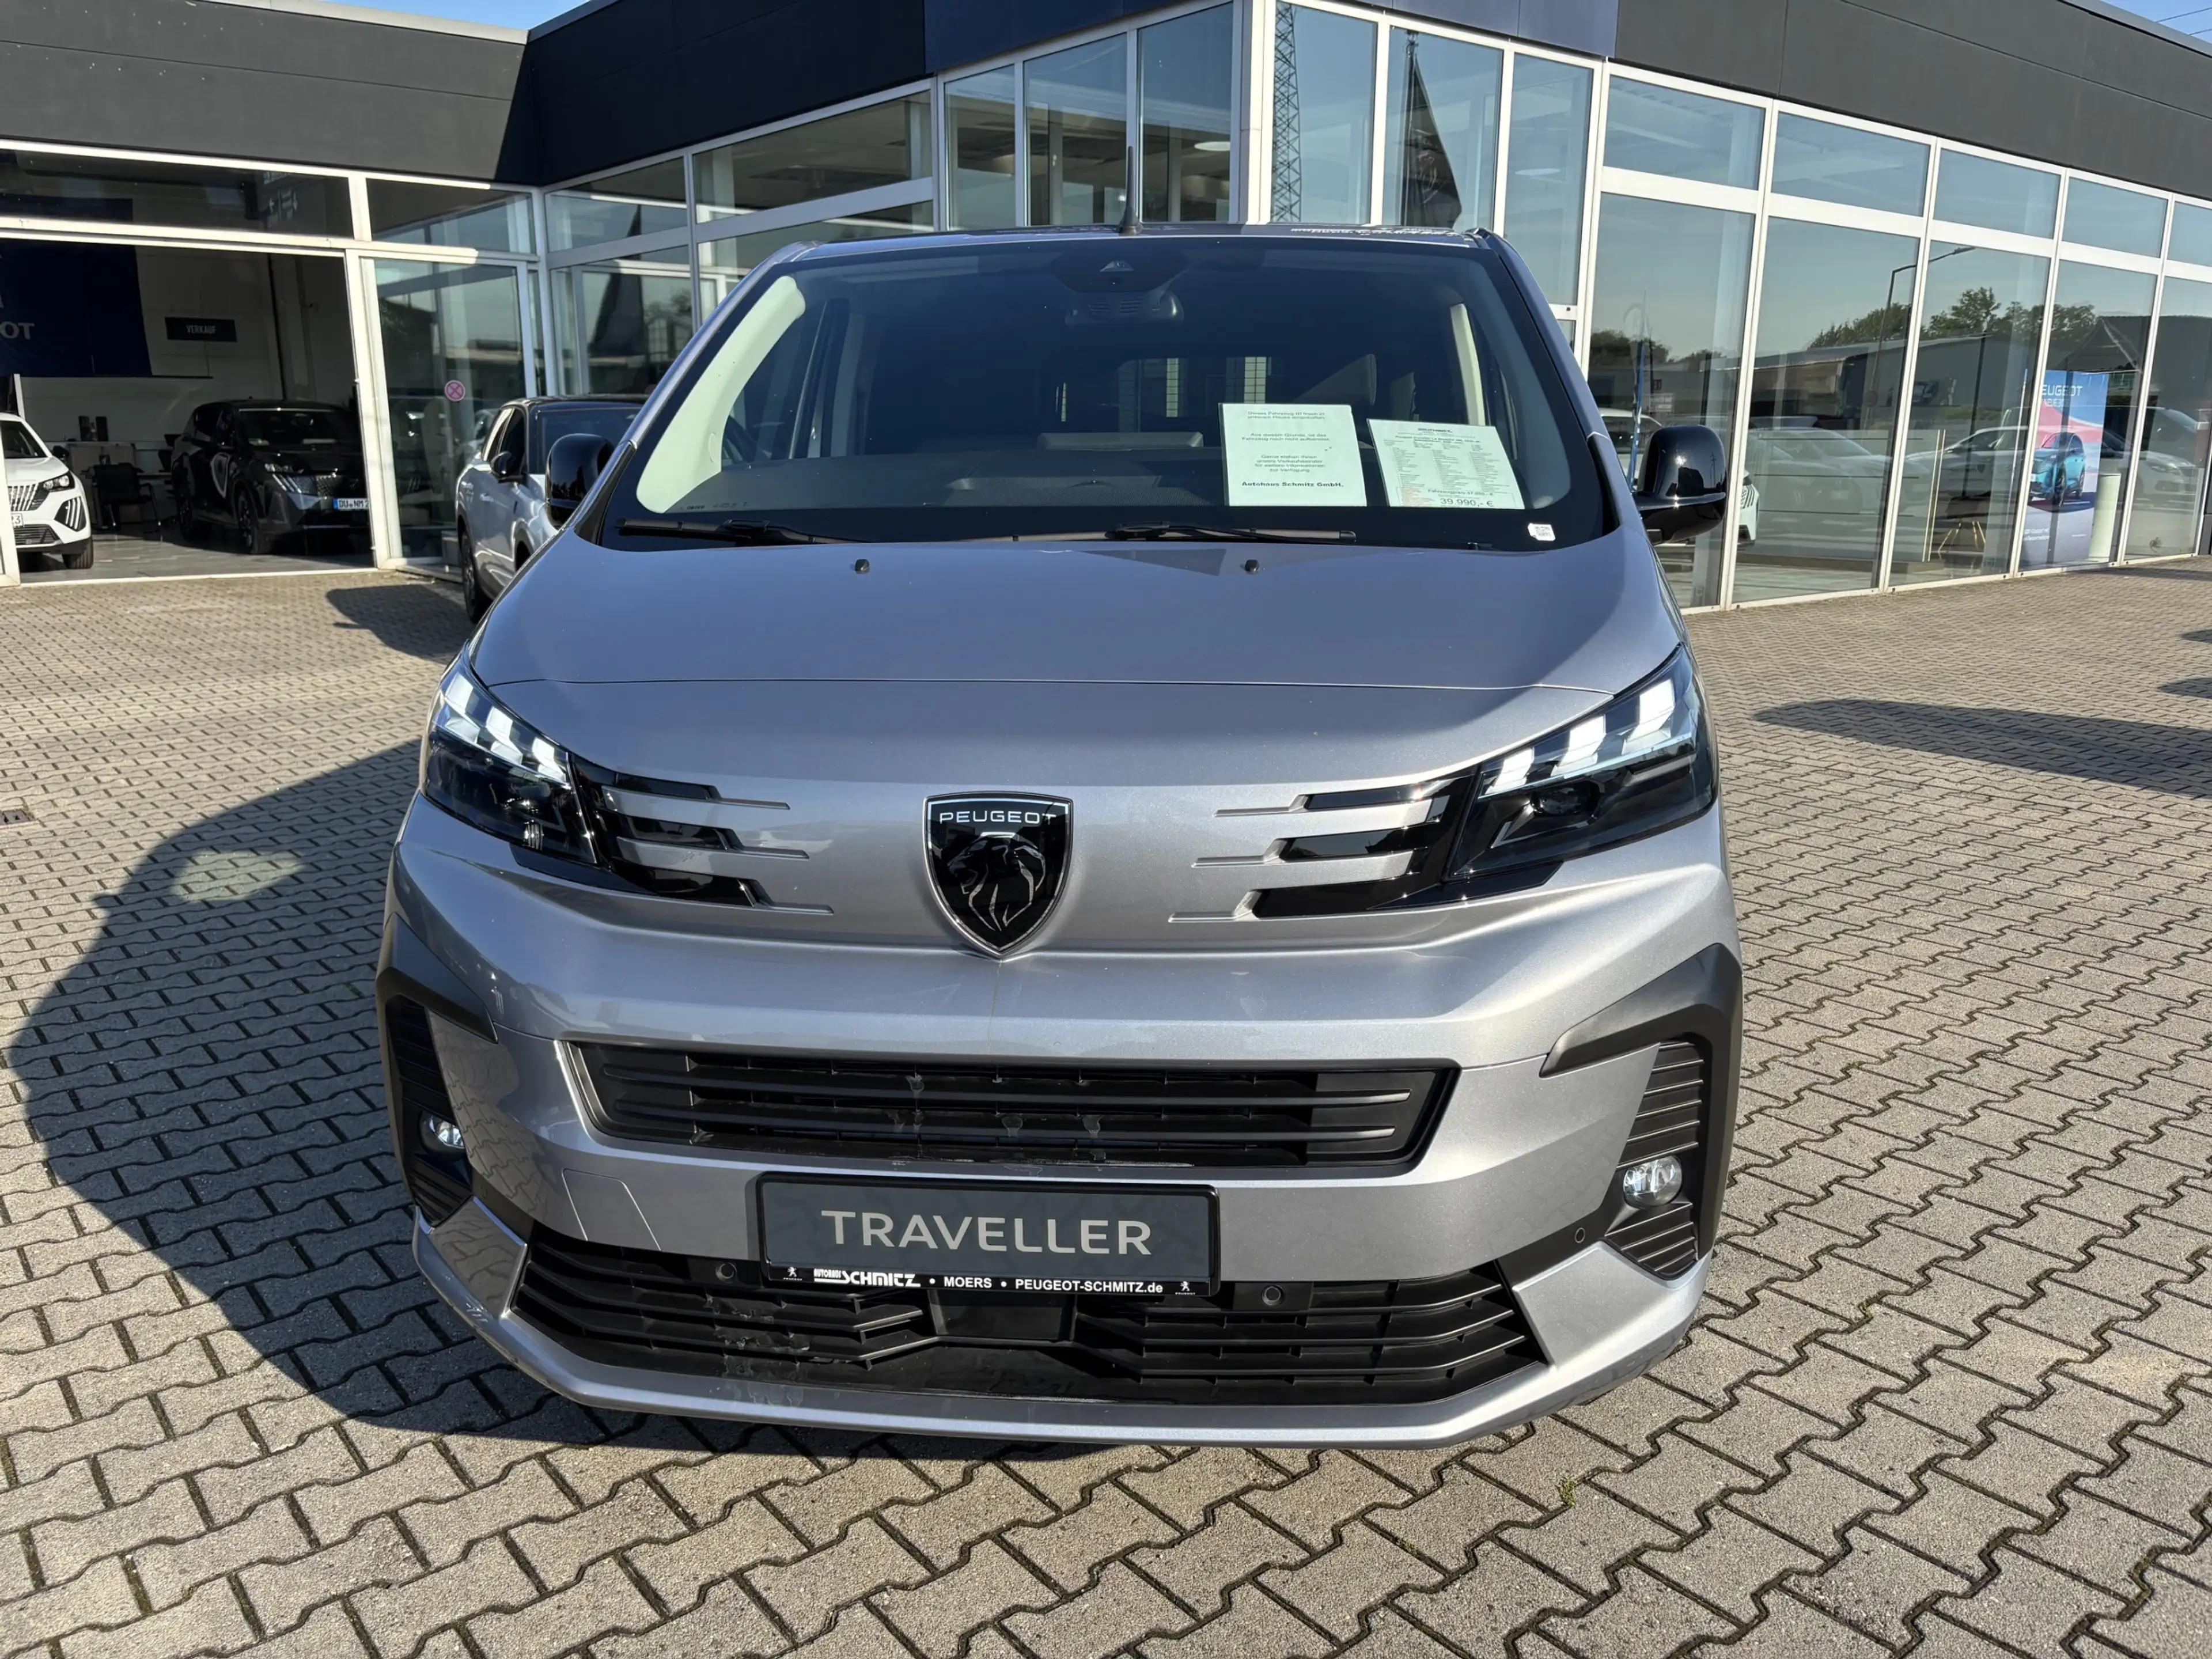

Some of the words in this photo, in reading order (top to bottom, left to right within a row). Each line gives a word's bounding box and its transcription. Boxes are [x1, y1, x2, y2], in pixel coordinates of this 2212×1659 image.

[186, 324, 217, 334] VERKAUF
[2041, 385, 2083, 396] EUGEOT
[940, 810, 1056, 825] PEUGEOT
[821, 1210, 1152, 1255] TRAVELLER
[813, 1268, 842, 1278] AUTOHAUS
[842, 1270, 921, 1287] SCHMITZ
[944, 1276, 993, 1289] MOERS
[1015, 1278, 1163, 1293] PEUGEOT-SCHMITZ.de
